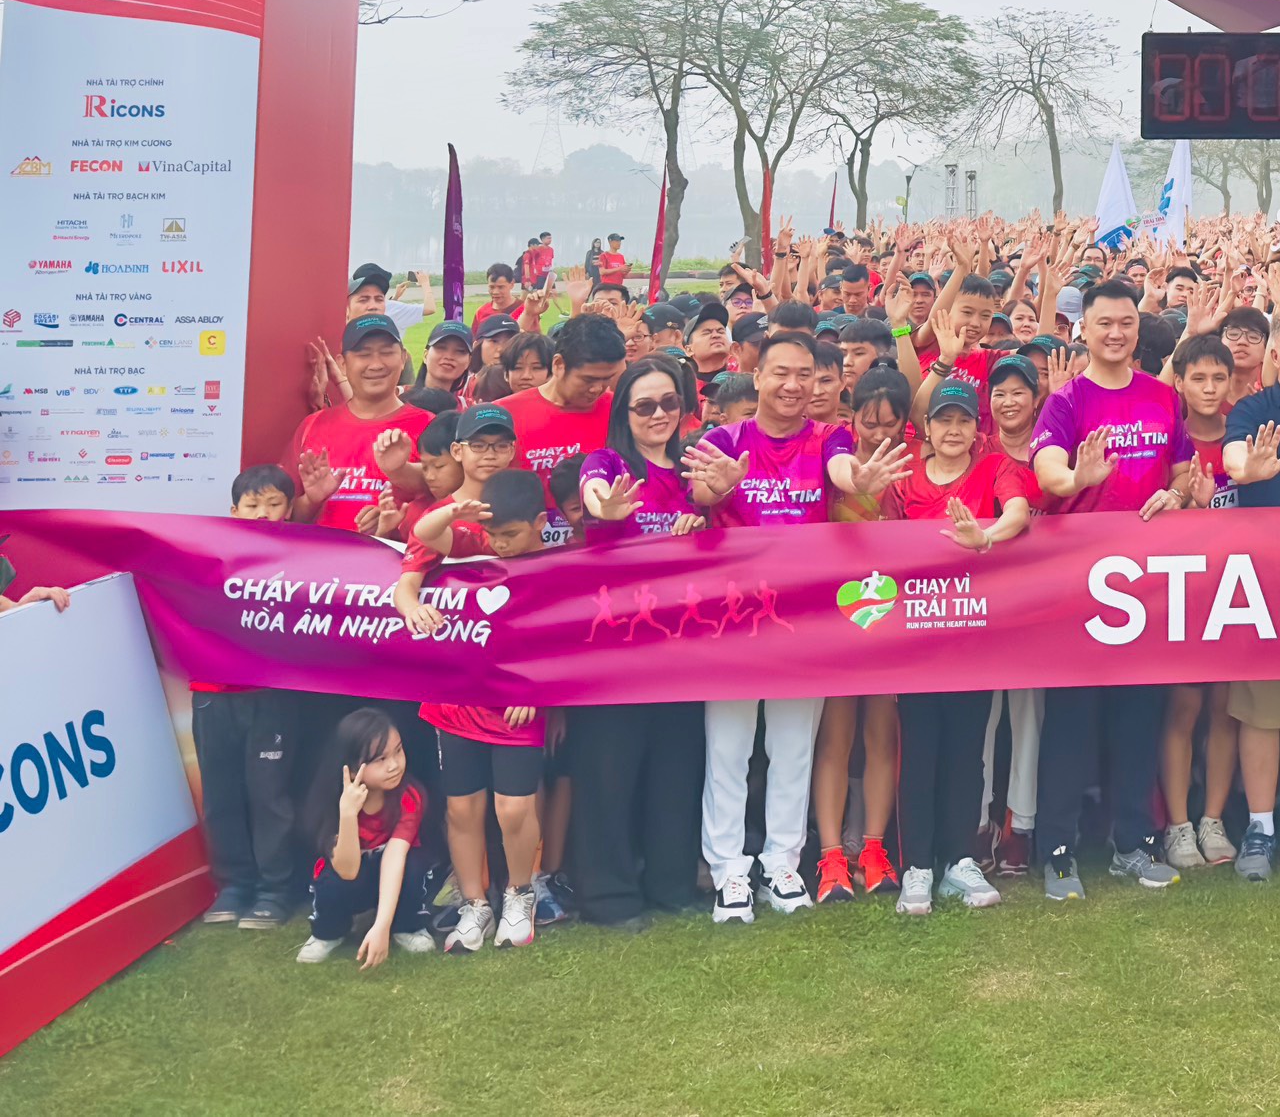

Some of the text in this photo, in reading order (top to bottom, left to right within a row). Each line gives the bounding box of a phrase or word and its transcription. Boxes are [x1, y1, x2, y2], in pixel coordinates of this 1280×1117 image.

[106, 78, 117, 86] TÀI
[120, 79, 137, 87] TRỢ
[139, 78, 164, 86] CHÍNH
[72, 139, 89, 147] NHÀ
[92, 139, 104, 147] TÀI
[106, 140, 123, 148] TRỢ
[70, 160, 232, 175] FECON VinaCapital
[74, 192, 90, 200] NHÀ
[93, 192, 105, 200] TÀI
[107, 193, 124, 201] TRỢ
[127, 193, 149, 202] BẠCH
[38, 261, 72, 269] YAMAHA
[162, 260, 203, 273] LIXIL
[110, 293, 127, 301] TRỢ
[78, 314, 223, 324] YAMAHA CENTRAL ASSA ABLOY
[109, 368, 126, 376] TRỢ
[128, 368, 145, 376] BẠC
[1142, 433, 1168, 445] TIM
[788, 488, 821, 503] TIM
[223, 572, 303, 606] CHẠY
[308, 578, 339, 605] VÌ
[343, 583, 397, 607] TRÁ
[904, 573, 971, 595] CHẠY VÌ
[904, 596, 987, 617] TRÁI TIM
[240, 606, 285, 633] HÒA
[293, 608, 332, 635] ÂM
[339, 615, 405, 644] NHỊP
[906, 621, 919, 629] RUN
